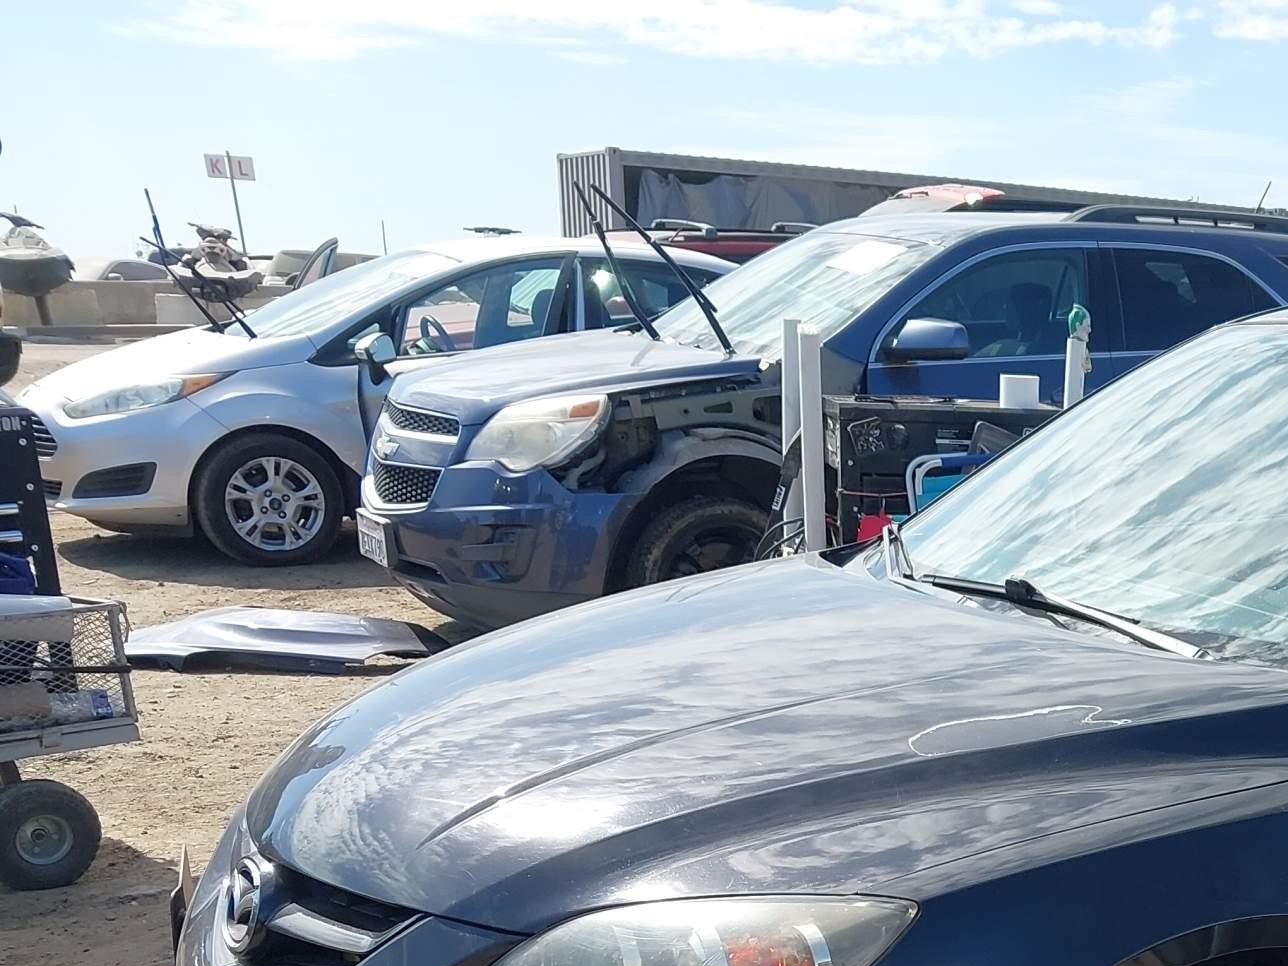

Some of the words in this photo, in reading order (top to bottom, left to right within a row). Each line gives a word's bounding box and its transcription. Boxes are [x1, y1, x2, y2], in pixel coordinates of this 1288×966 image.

[208, 158, 223, 175] K
[238, 159, 249, 177] L
[0, 415, 22, 431] ON
